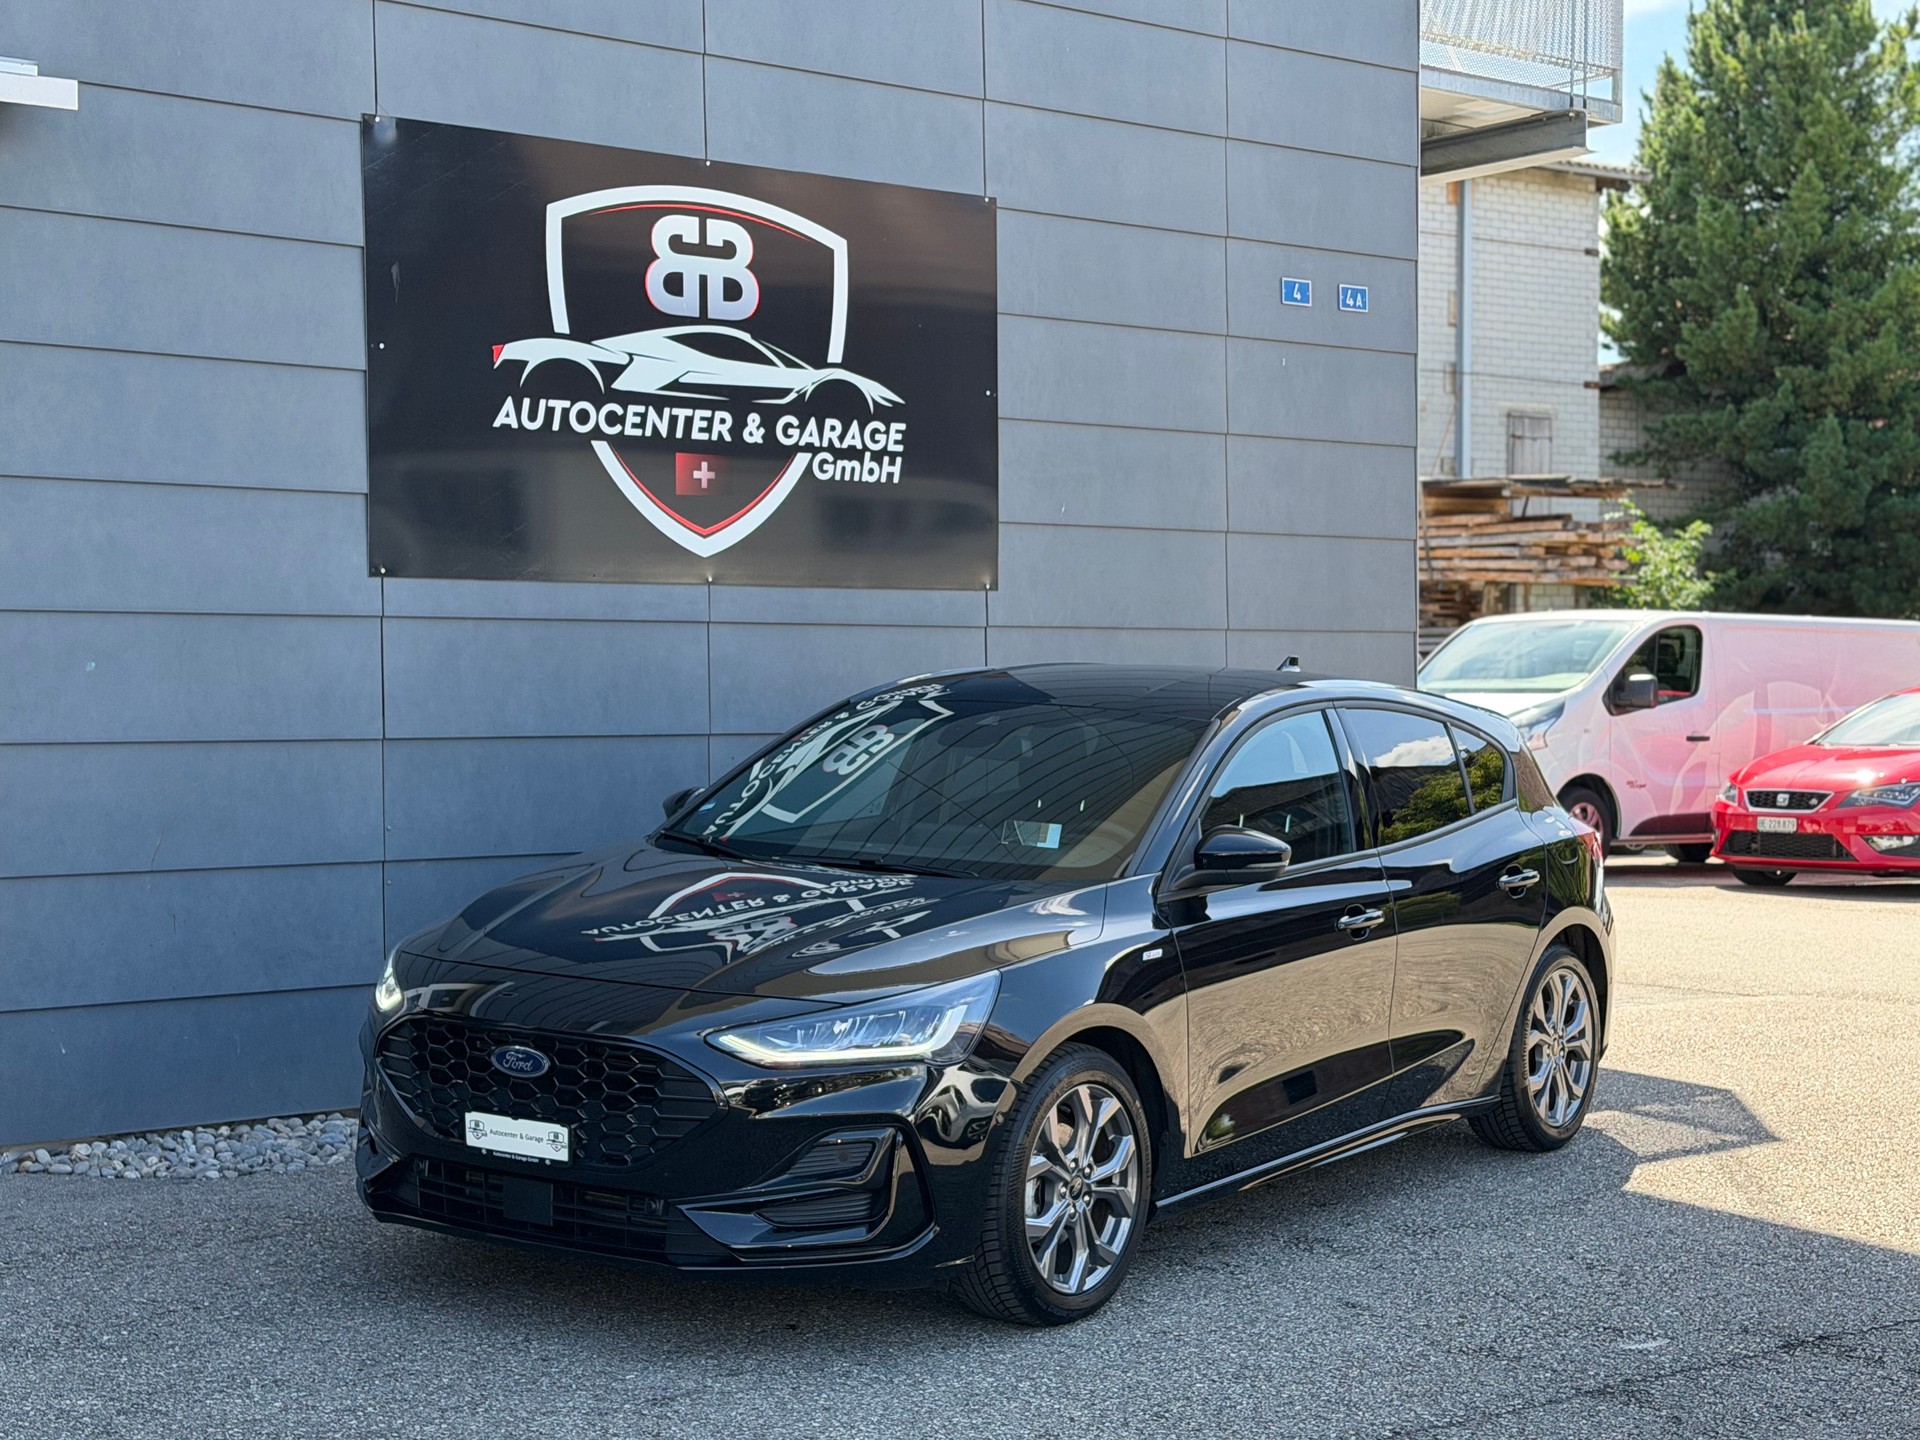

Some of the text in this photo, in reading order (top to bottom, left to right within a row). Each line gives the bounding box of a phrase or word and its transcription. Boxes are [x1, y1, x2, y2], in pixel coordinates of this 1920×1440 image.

[1293, 283, 1302, 301] 4
[1345, 289, 1363, 308] 4A
[493, 395, 907, 452] AUTOCENTER & GARAGE
[812, 451, 902, 484] GmbH
[502, 1051, 533, 1072] Ford
[490, 1129, 518, 1139] Autocenter
[525, 1134, 544, 1143] Garage
